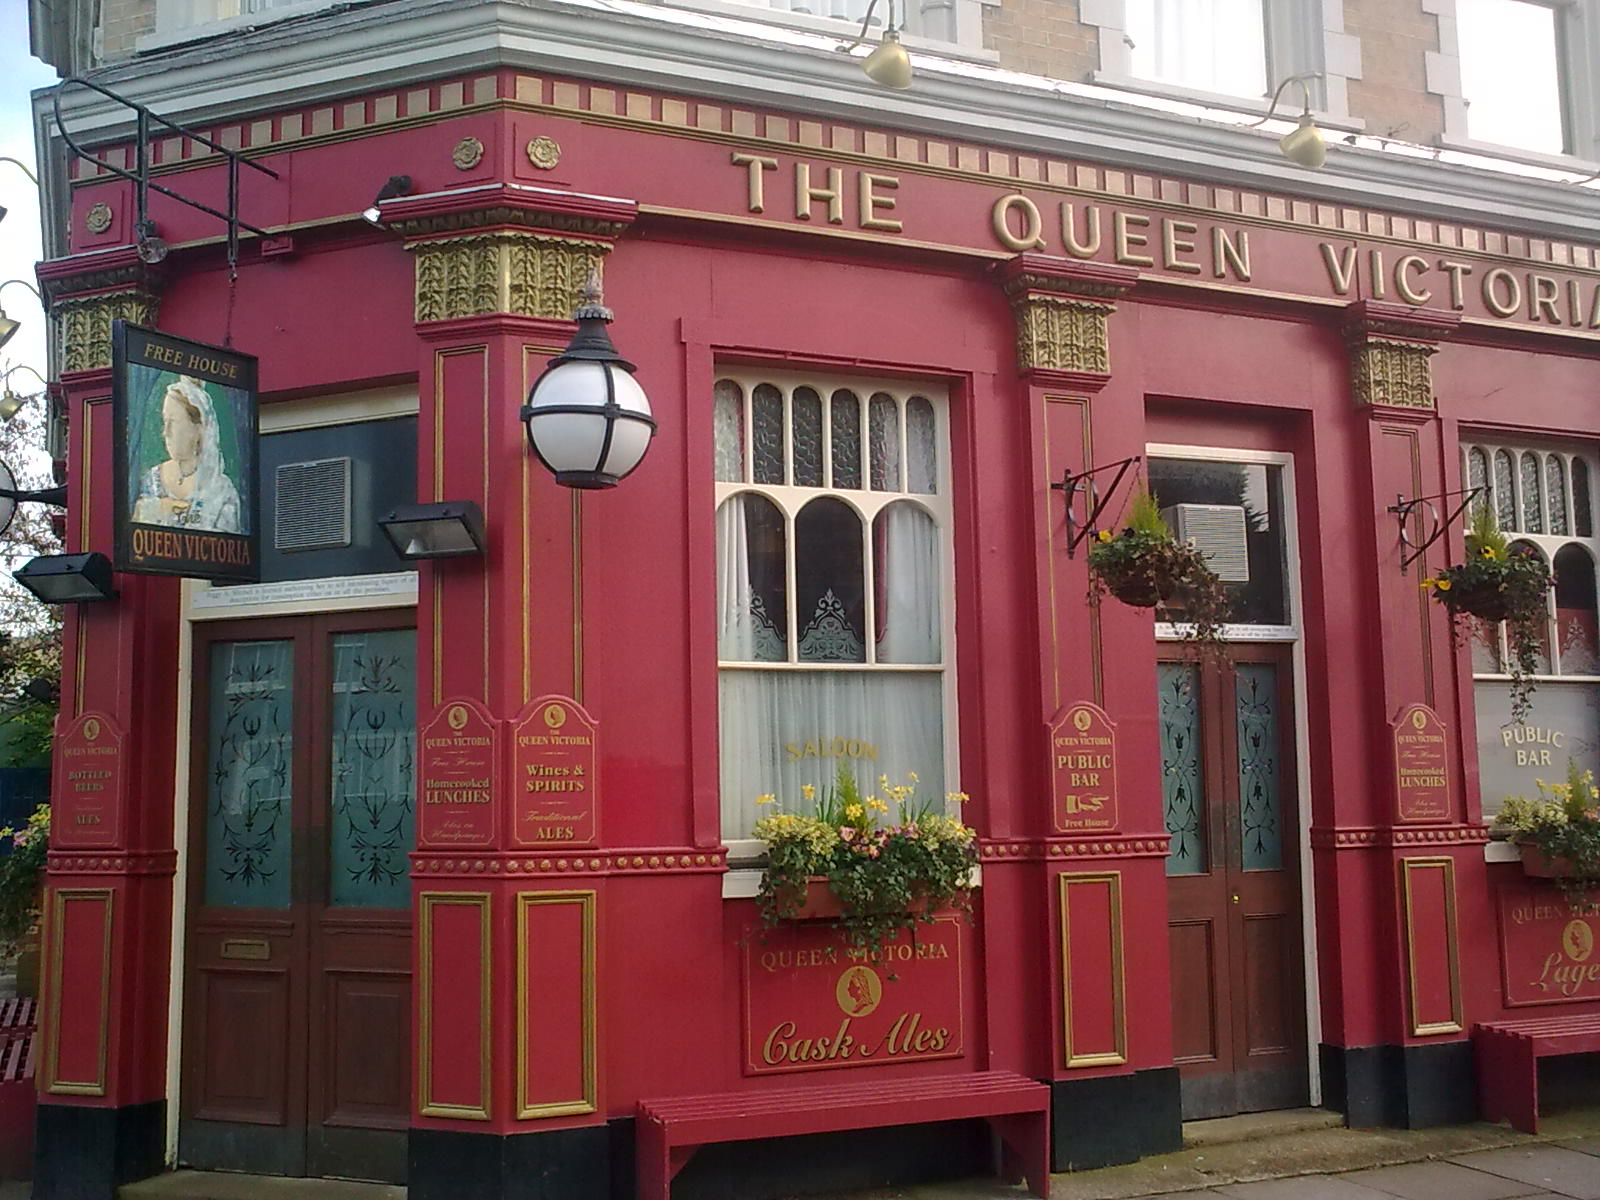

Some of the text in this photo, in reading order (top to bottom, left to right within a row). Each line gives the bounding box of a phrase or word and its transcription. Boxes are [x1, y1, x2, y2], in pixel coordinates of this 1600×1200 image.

[731, 151, 903, 233] THE
[992, 194, 1251, 282] QUEEN
[144, 343, 239, 379] FREE HOUSE
[133, 529, 250, 565] QUEEN VICTORIA
[426, 737, 490, 749] QUEEN VICTORIA
[519, 736, 592, 747] QUEEN VICTORIA
[1055, 737, 1079, 748] QUEEN
[1502, 727, 1565, 748] PUBLIC
[785, 736, 879, 762] SALOON
[1057, 755, 1111, 769] PUBLIC
[1516, 750, 1552, 766] BAR
[526, 764, 585, 776] Wines &
[426, 777, 490, 789] Homecooked
[526, 780, 585, 793] SPIRITS
[1071, 773, 1100, 787] BAR
[1400, 776, 1446, 788] LUNCHES
[426, 790, 491, 804] LUNCHES
[536, 826, 574, 840] ALES
[1512, 906, 1562, 925] QUEEN
[761, 949, 839, 972] QUEEN
[763, 1012, 950, 1065] Cask Ales
